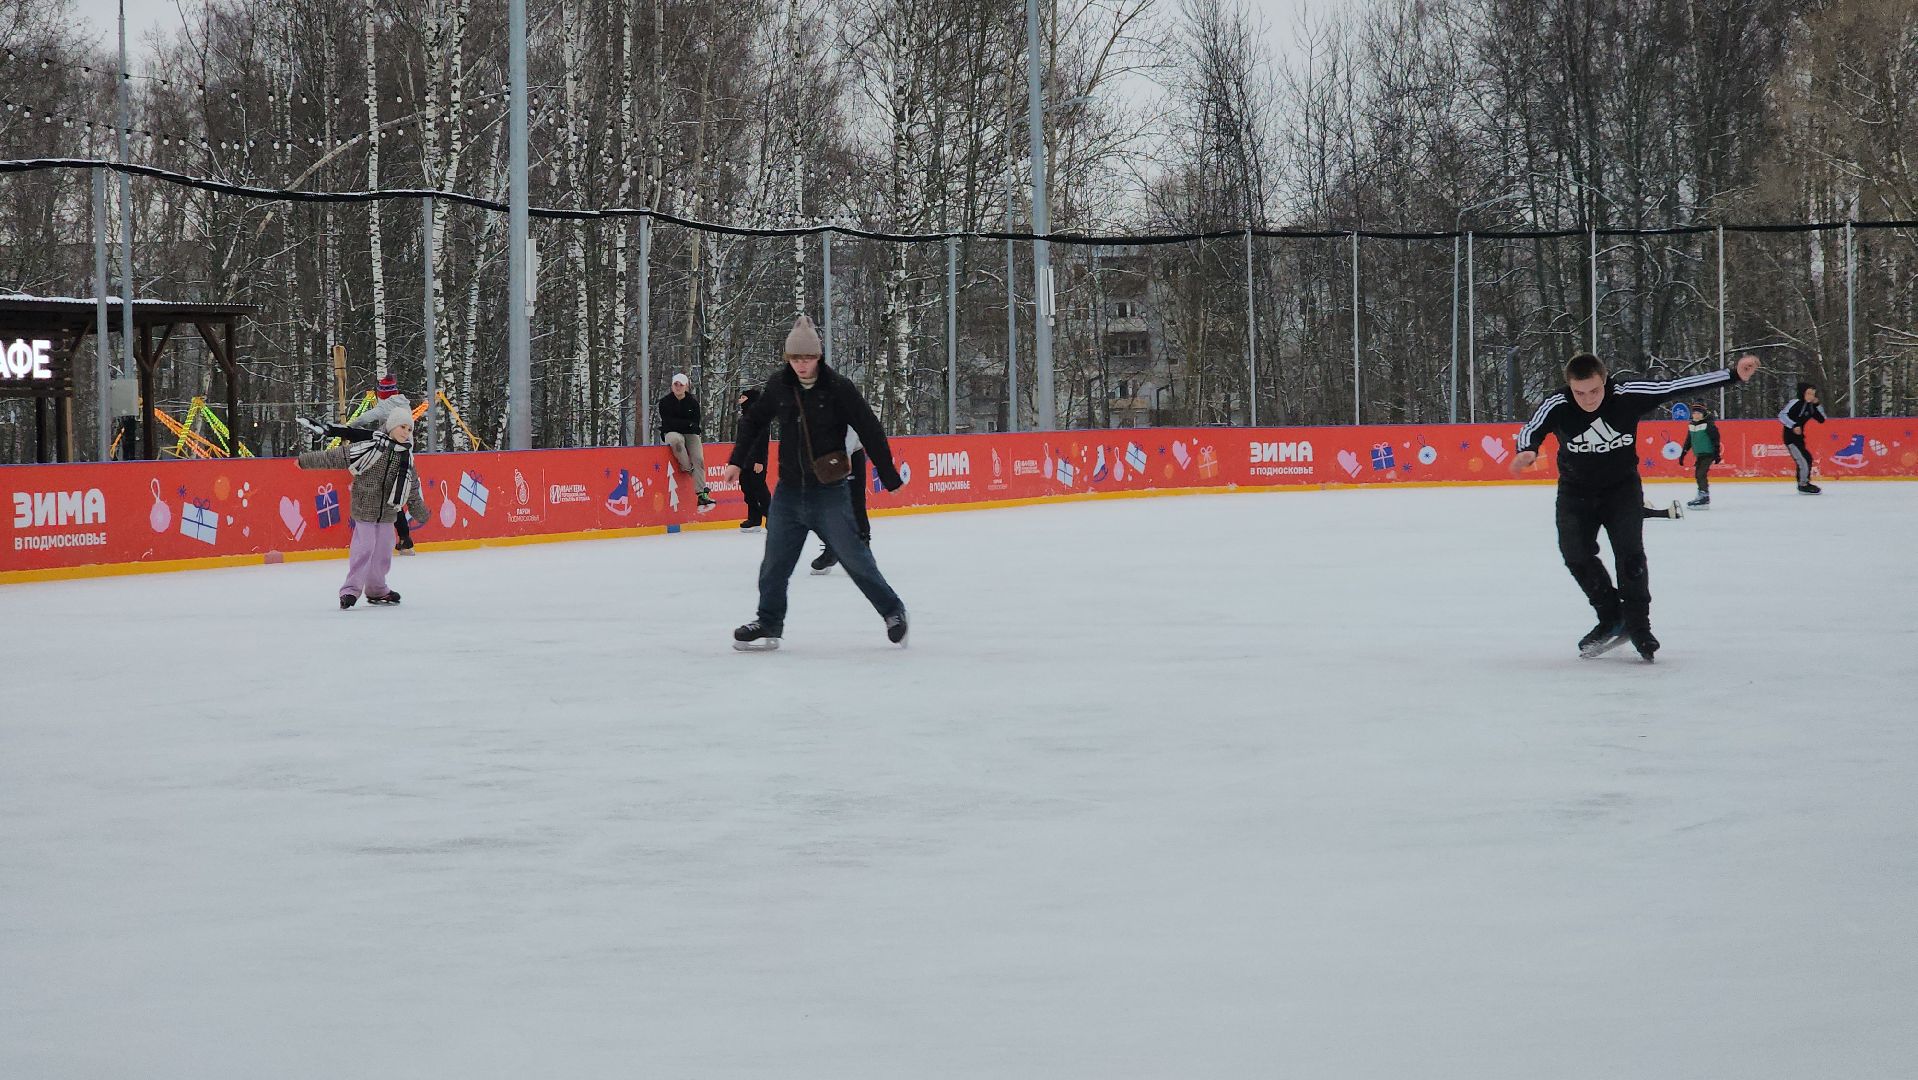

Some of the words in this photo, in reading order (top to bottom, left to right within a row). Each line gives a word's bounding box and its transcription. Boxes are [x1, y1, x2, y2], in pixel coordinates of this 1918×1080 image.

[1249, 441, 1313, 463] ЗИМА
[1566, 433, 1634, 453] adidas
[928, 450, 970, 478] ЗИМА
[1256, 466, 1314, 476] ПОДМОСКОВЬЕ
[13, 488, 106, 529] ЗИМА
[24, 532, 107, 550] ПОДМОСКОВЬЕ
